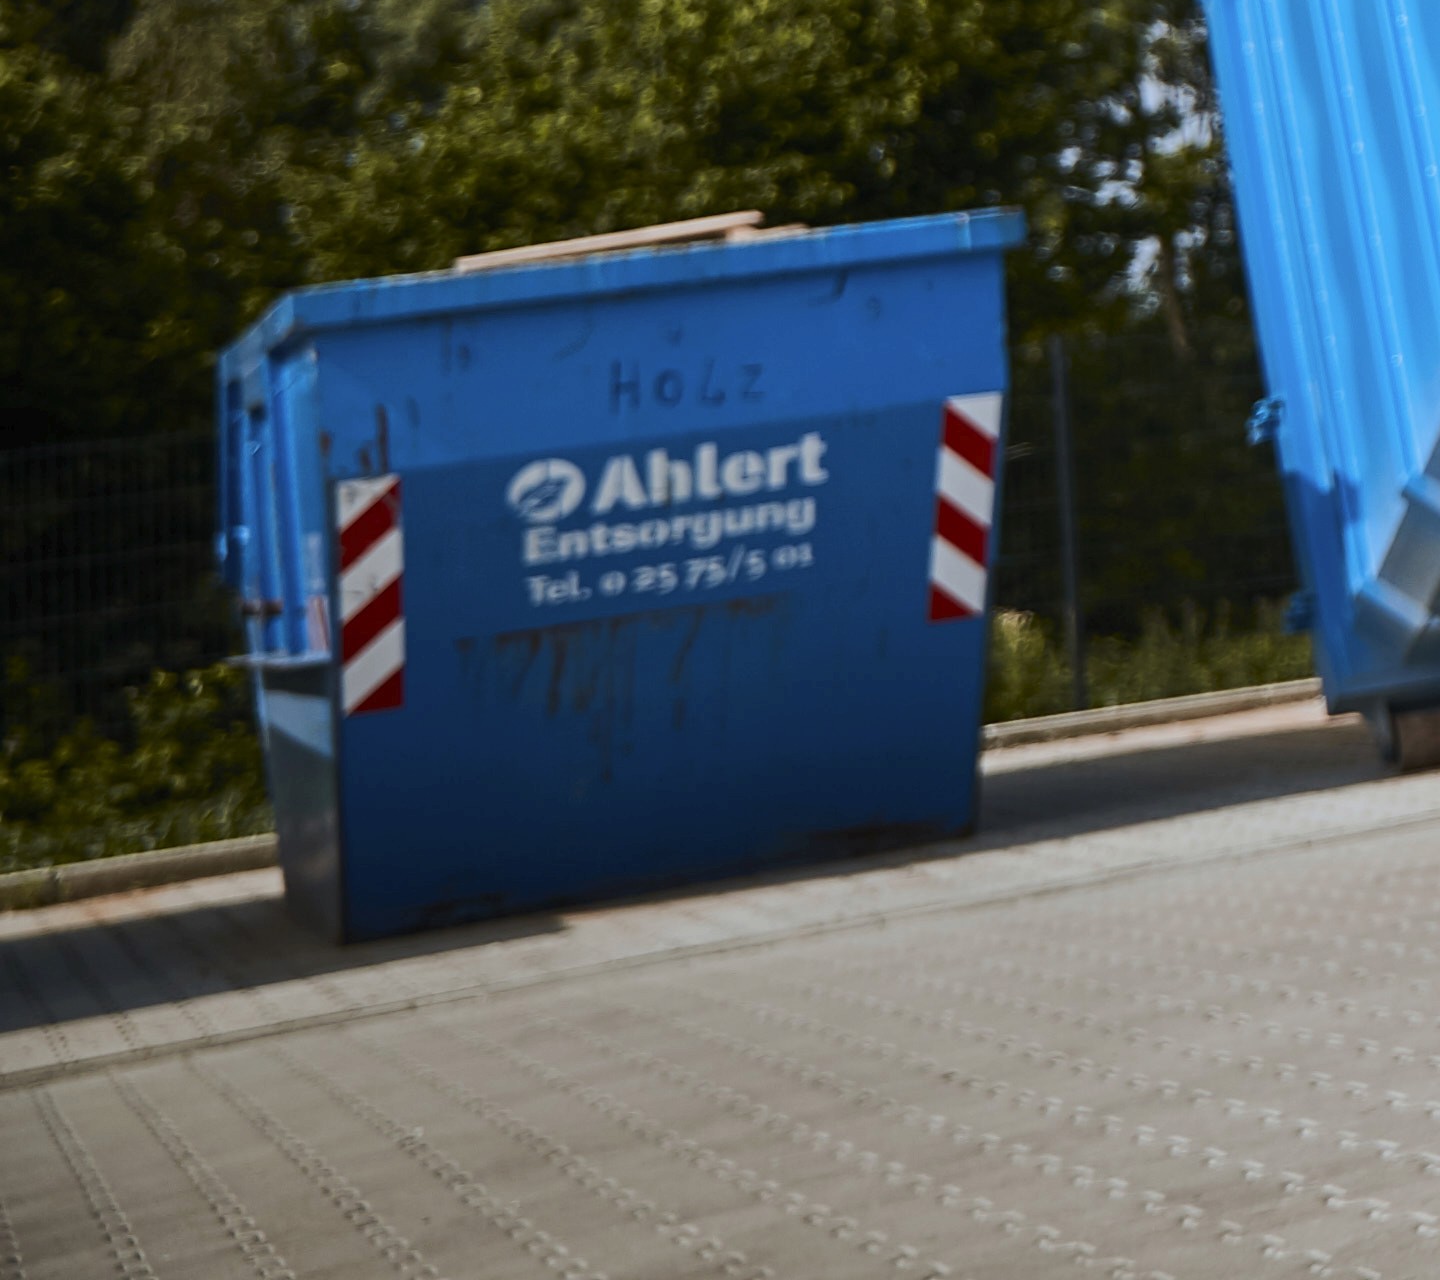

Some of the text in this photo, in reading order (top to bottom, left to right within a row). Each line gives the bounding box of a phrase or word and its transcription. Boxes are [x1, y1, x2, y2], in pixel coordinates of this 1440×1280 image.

[591, 431, 829, 515] Ahlert
[524, 496, 817, 566] Entsorgung
[526, 570, 592, 607] Tel.
